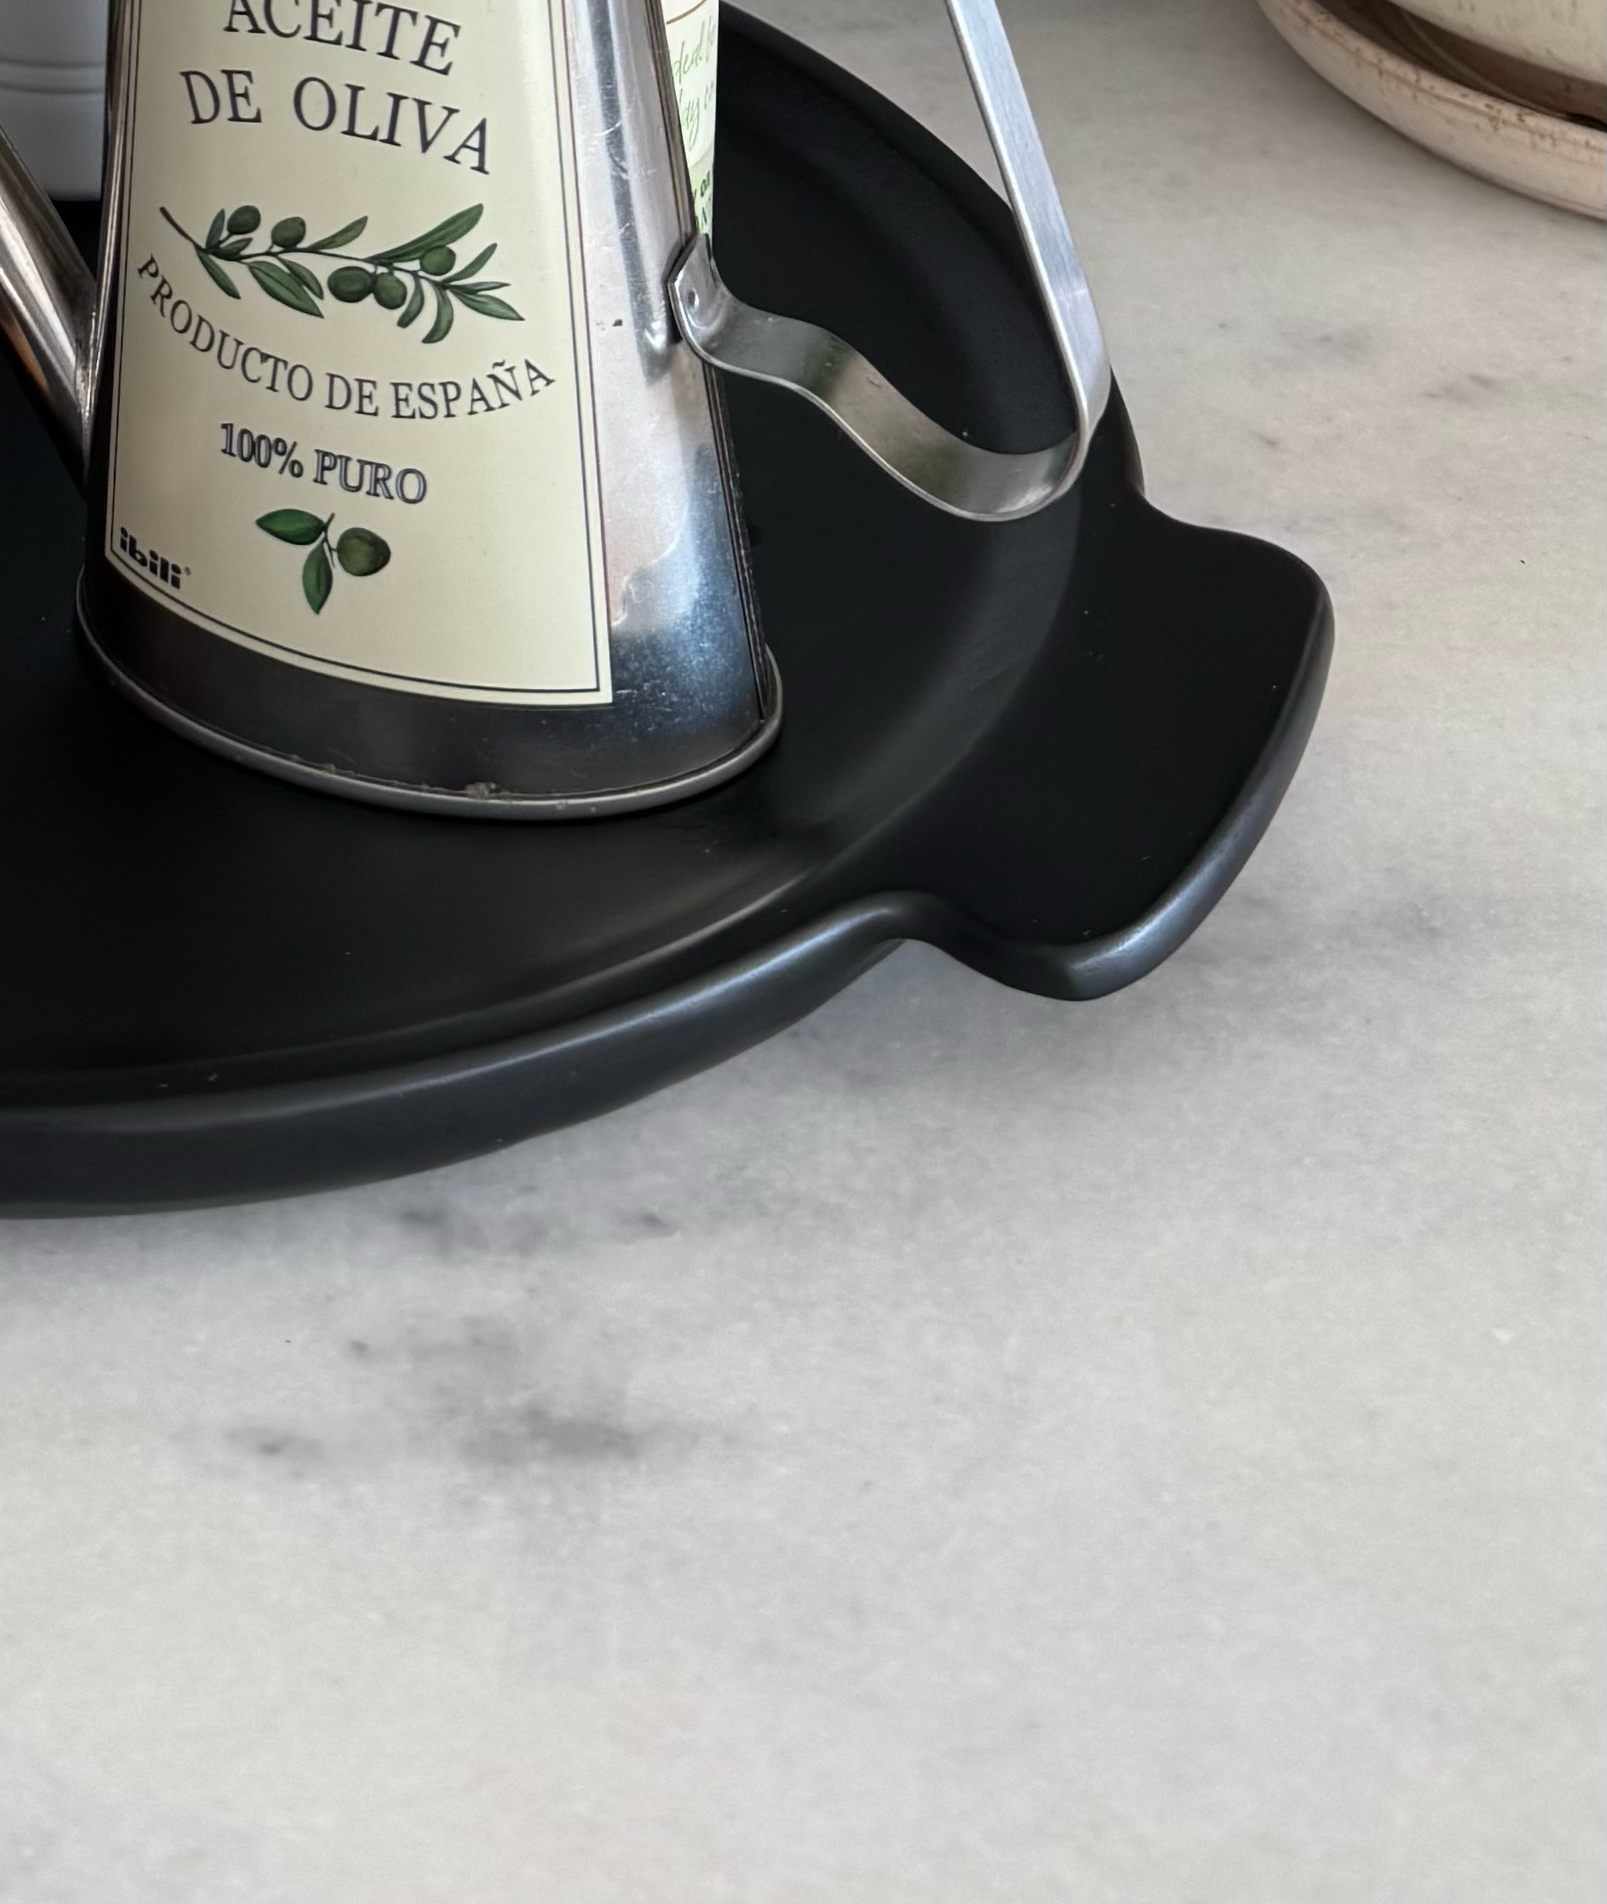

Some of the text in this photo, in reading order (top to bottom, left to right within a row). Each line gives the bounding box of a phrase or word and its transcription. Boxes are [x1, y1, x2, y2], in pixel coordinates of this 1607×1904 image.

[180, 69, 490, 175] DE OLIVA
[136, 254, 556, 420] PRODUCTO DE ESPAÑA
[220, 422, 428, 505] 100% PURO
